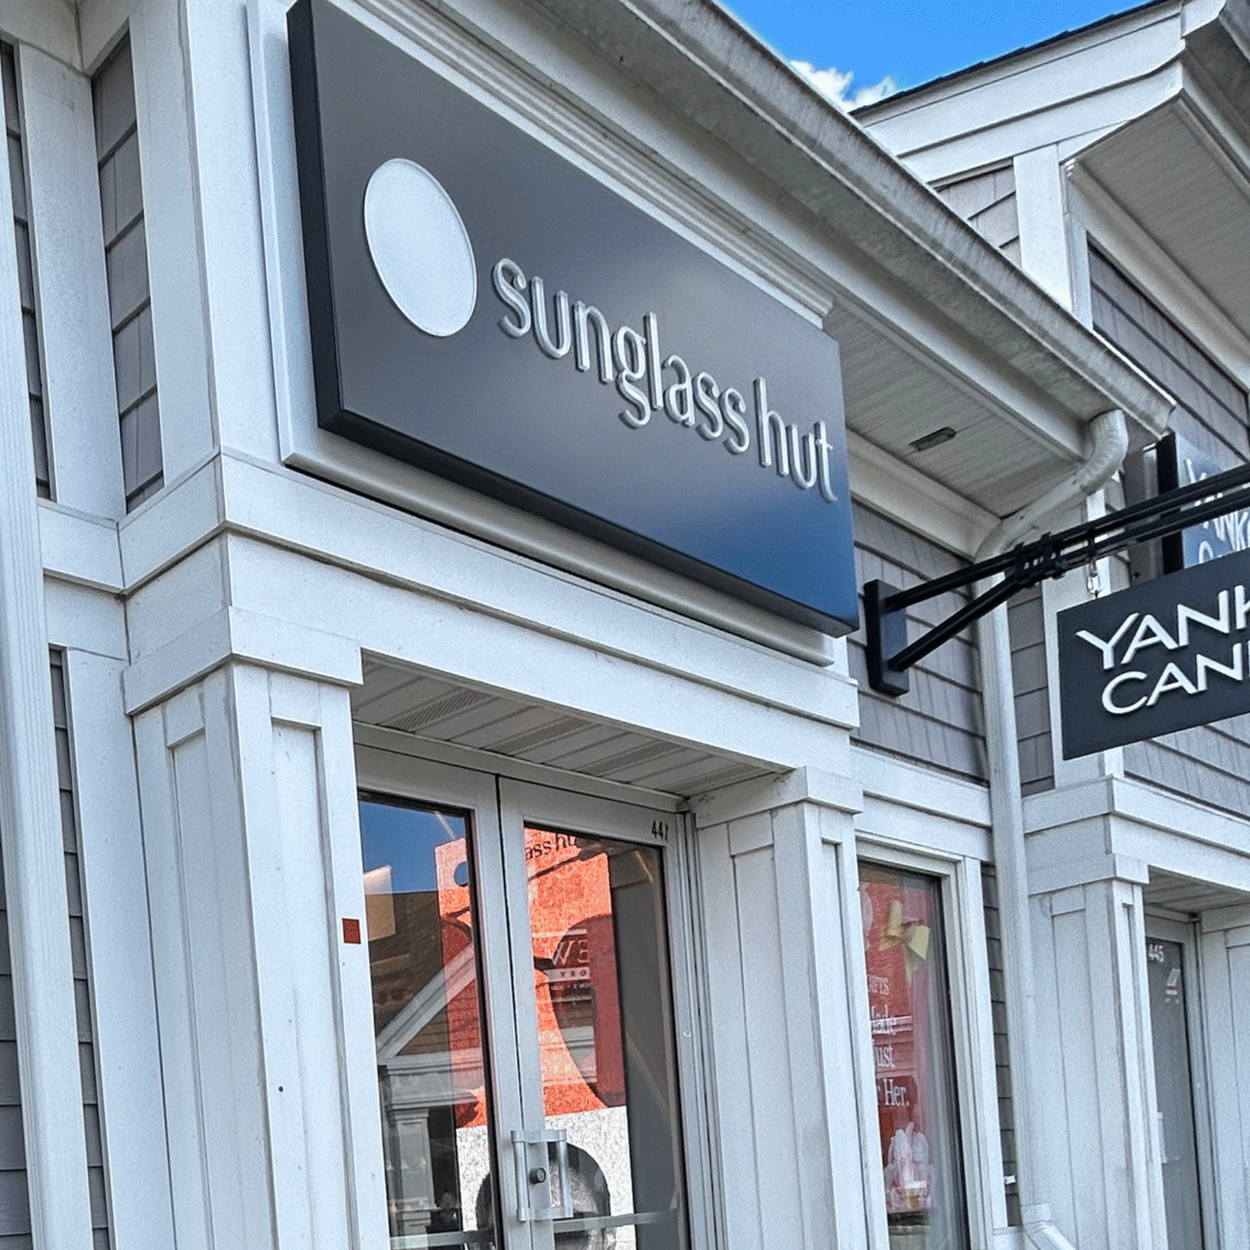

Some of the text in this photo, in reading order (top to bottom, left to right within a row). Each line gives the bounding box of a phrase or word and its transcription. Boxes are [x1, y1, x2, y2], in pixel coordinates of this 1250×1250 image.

[492, 257, 838, 501] sunglass hut
[1101, 640, 1250, 715] CAN
[875, 1046, 896, 1067] ust
[883, 1078, 910, 1106] Her.
